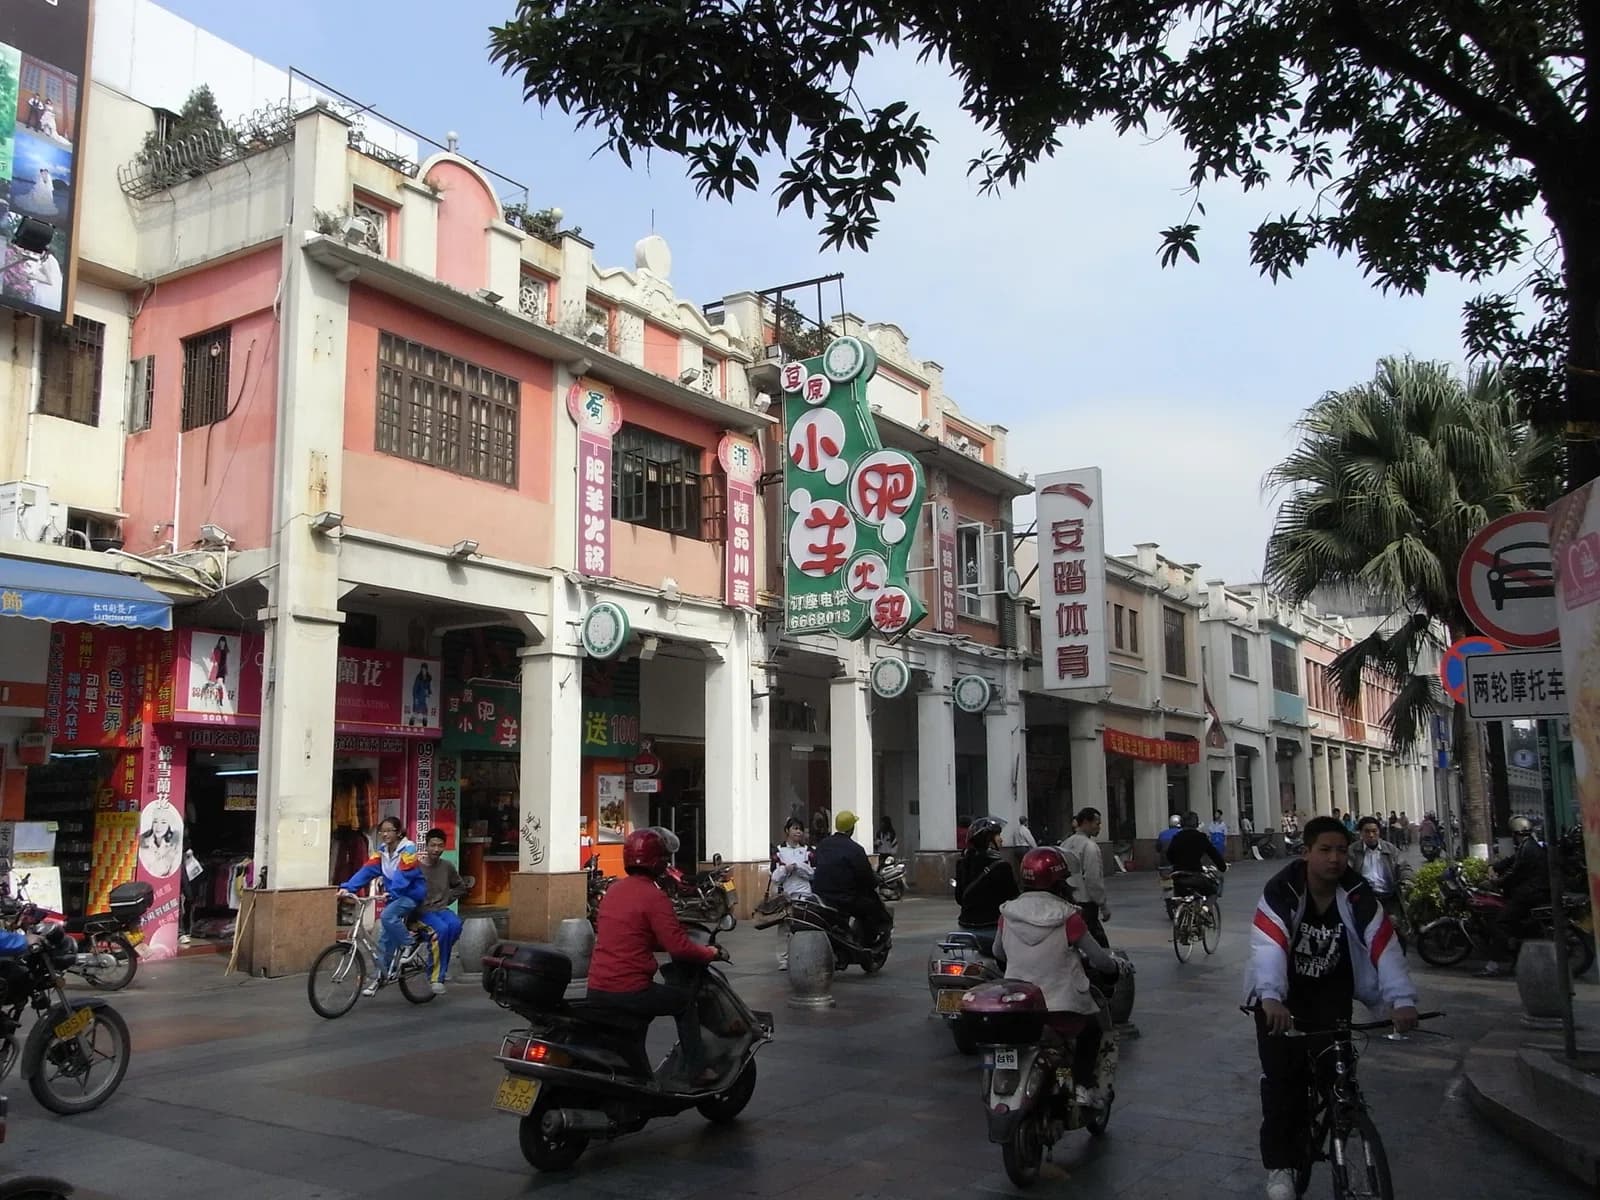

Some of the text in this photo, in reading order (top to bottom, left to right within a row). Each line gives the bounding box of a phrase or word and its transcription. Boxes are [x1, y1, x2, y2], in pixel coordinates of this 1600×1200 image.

[584, 456, 605, 572] 肥羊火锅
[733, 501, 750, 603] 精品川菜
[790, 591, 848, 611] 订座电话
[1052, 519, 1090, 680] 安踏体育
[1473, 668, 1566, 703] 两轮摩托车
